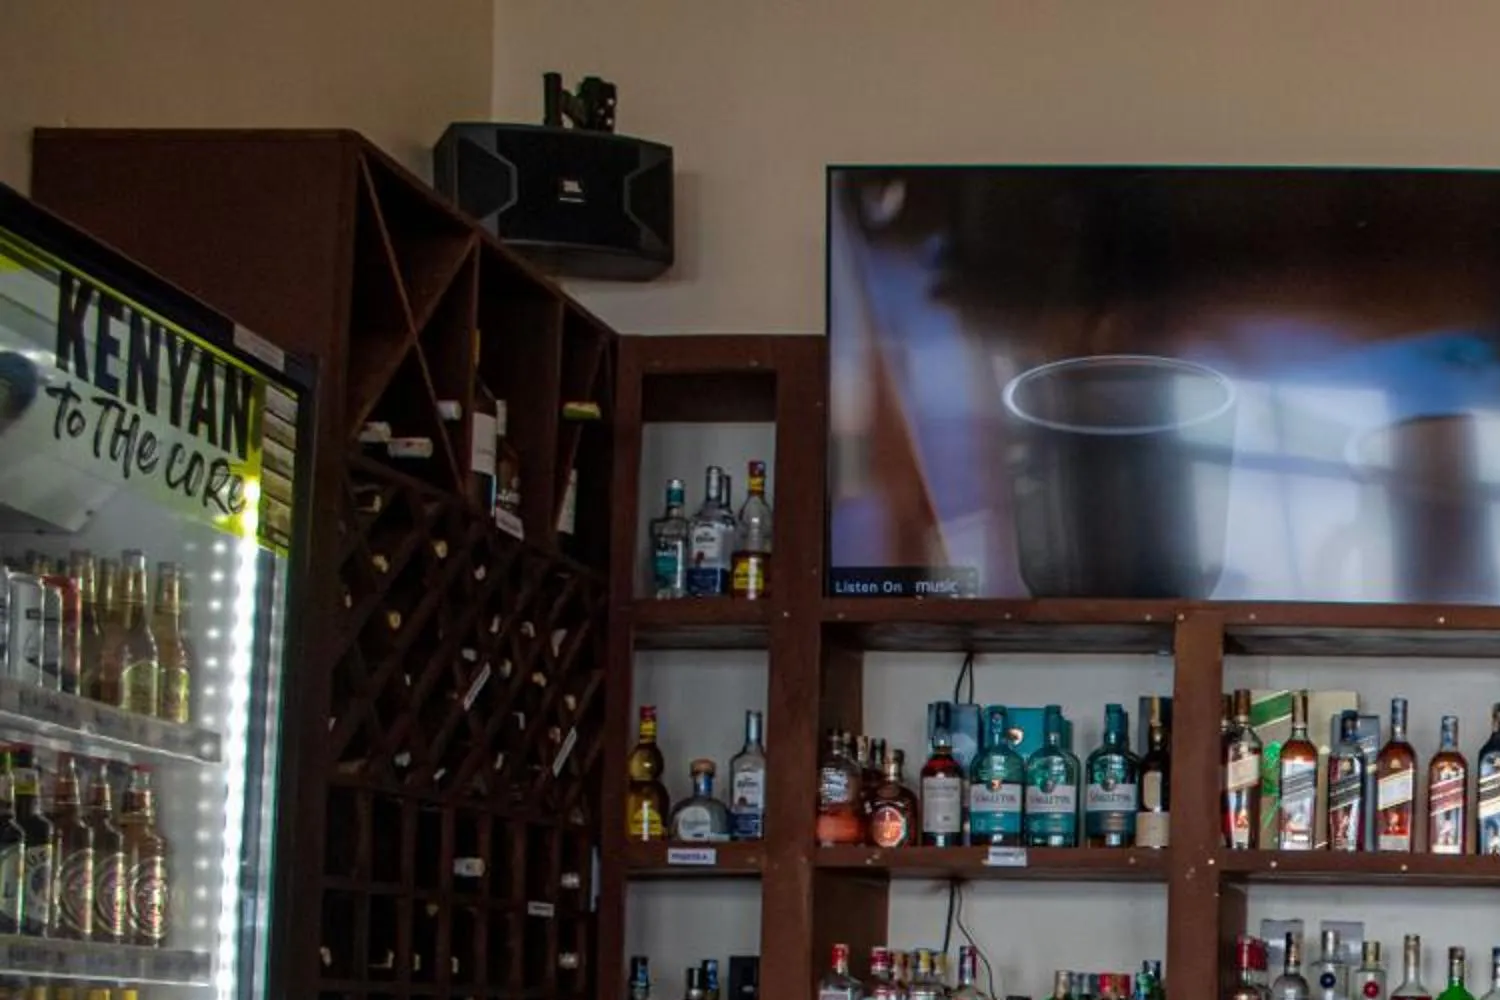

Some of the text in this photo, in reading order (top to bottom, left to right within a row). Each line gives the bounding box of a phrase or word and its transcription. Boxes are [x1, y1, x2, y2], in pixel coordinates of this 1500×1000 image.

[56, 270, 255, 463] KENYAN
[835, 578, 958, 593] Listen On music
